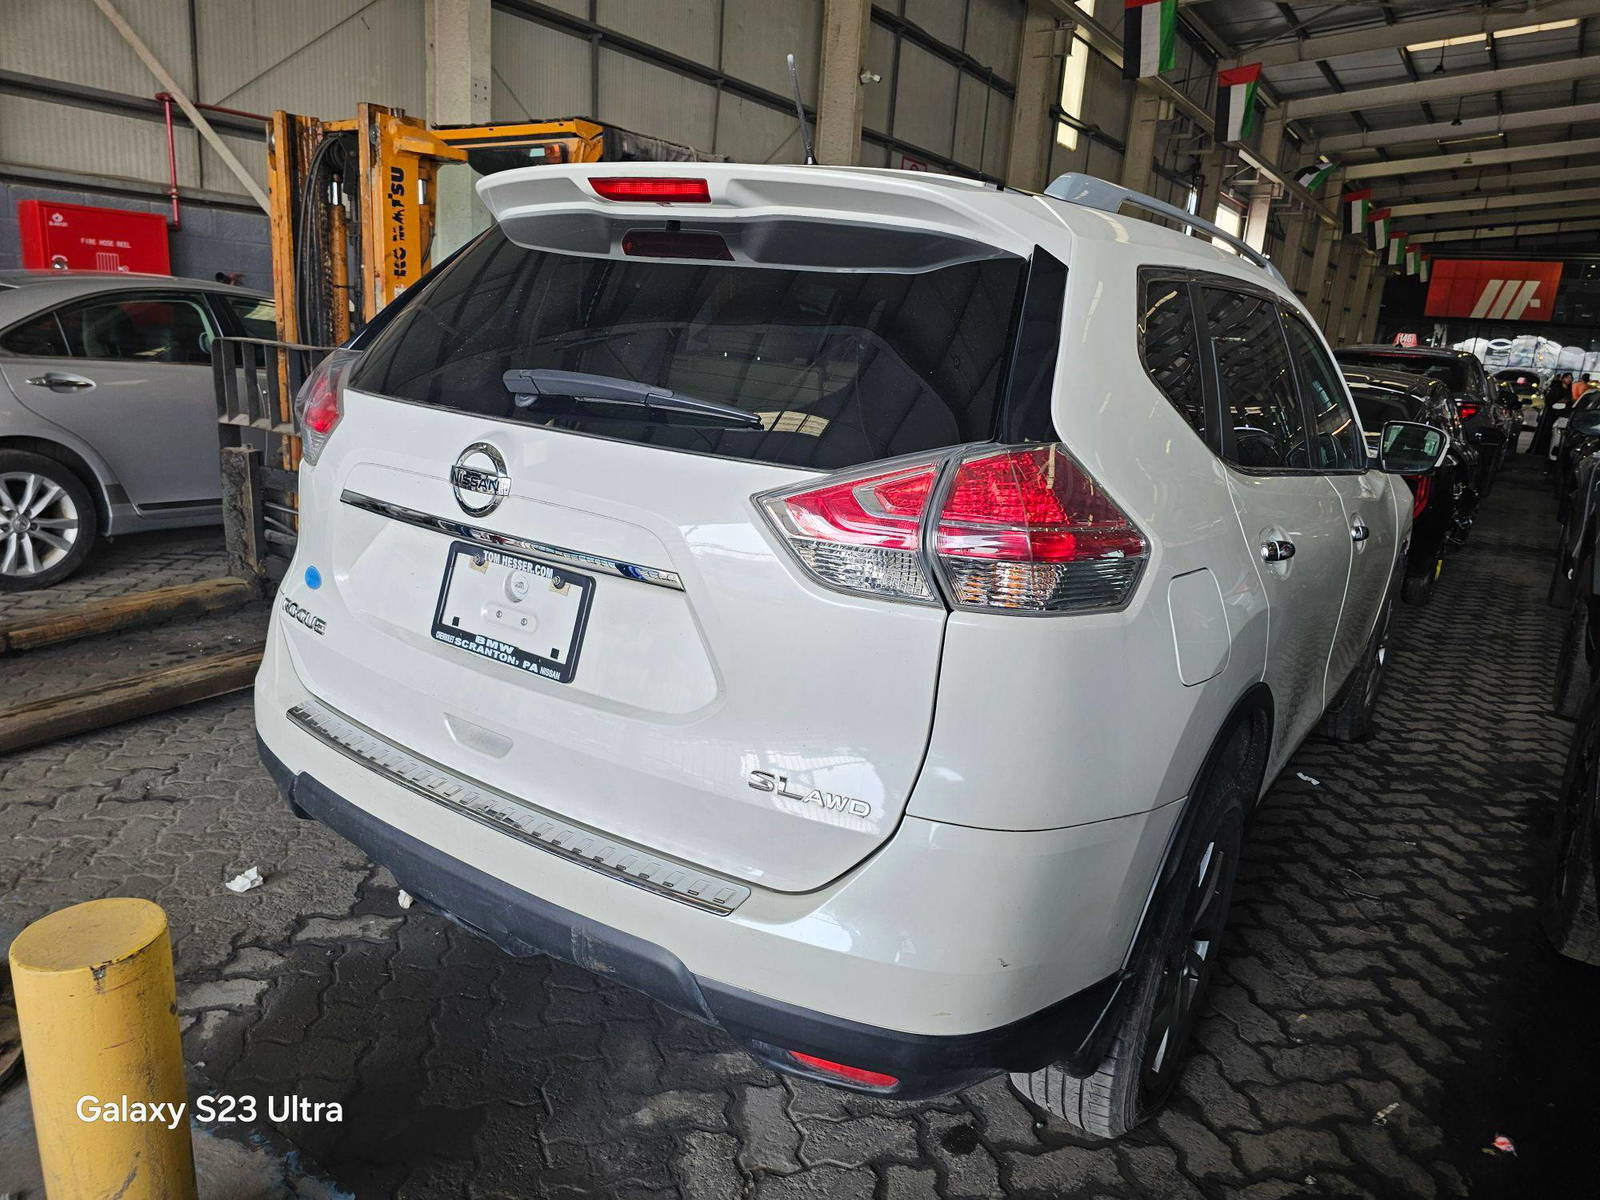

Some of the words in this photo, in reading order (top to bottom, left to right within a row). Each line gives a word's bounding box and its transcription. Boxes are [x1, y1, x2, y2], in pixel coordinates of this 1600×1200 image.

[81, 237, 97, 246] FIRE
[99, 239, 114, 247] HOSE
[116, 241, 132, 249] REEL
[451, 467, 500, 493] NISSAN
[483, 550, 500, 564] TOM
[502, 555, 554, 579] HESSER.COM
[475, 635, 514, 654] BMW
[454, 637, 519, 664] SCRANTON,
[522, 660, 539, 673] PA
[540, 666, 561, 680] NISSAN
